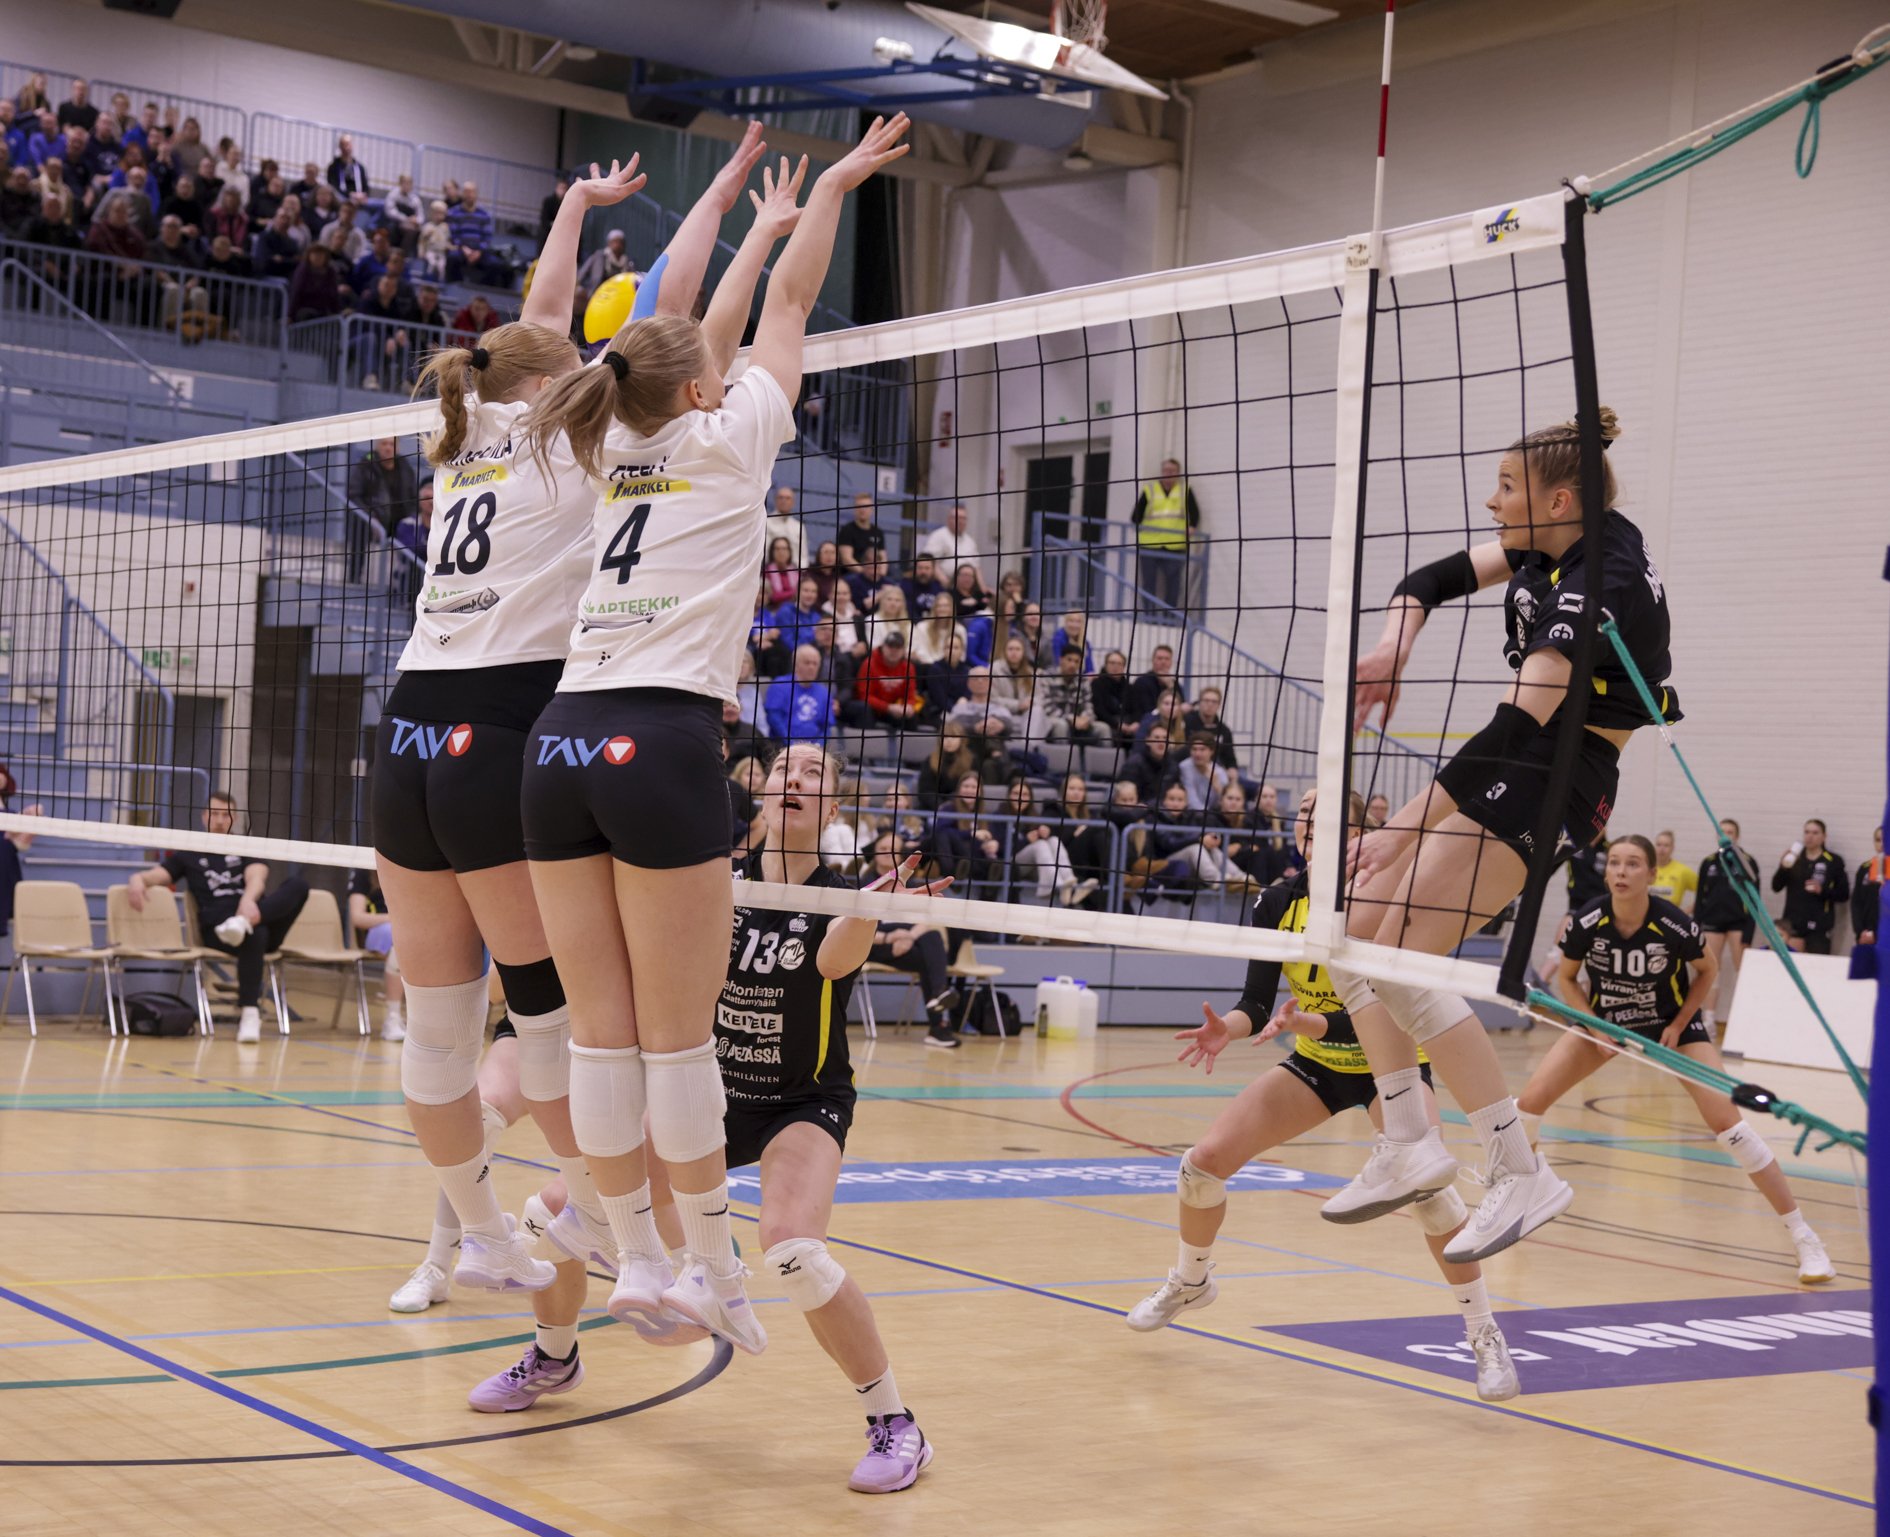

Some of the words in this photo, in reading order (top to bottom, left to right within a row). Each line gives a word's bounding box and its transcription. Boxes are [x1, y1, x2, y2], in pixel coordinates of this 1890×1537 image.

[1483, 217, 1520, 238] HUCK
[433, 491, 497, 577] 18
[599, 503, 652, 585] 4
[738, 928, 780, 974] 13
[1611, 948, 1645, 977] 10
